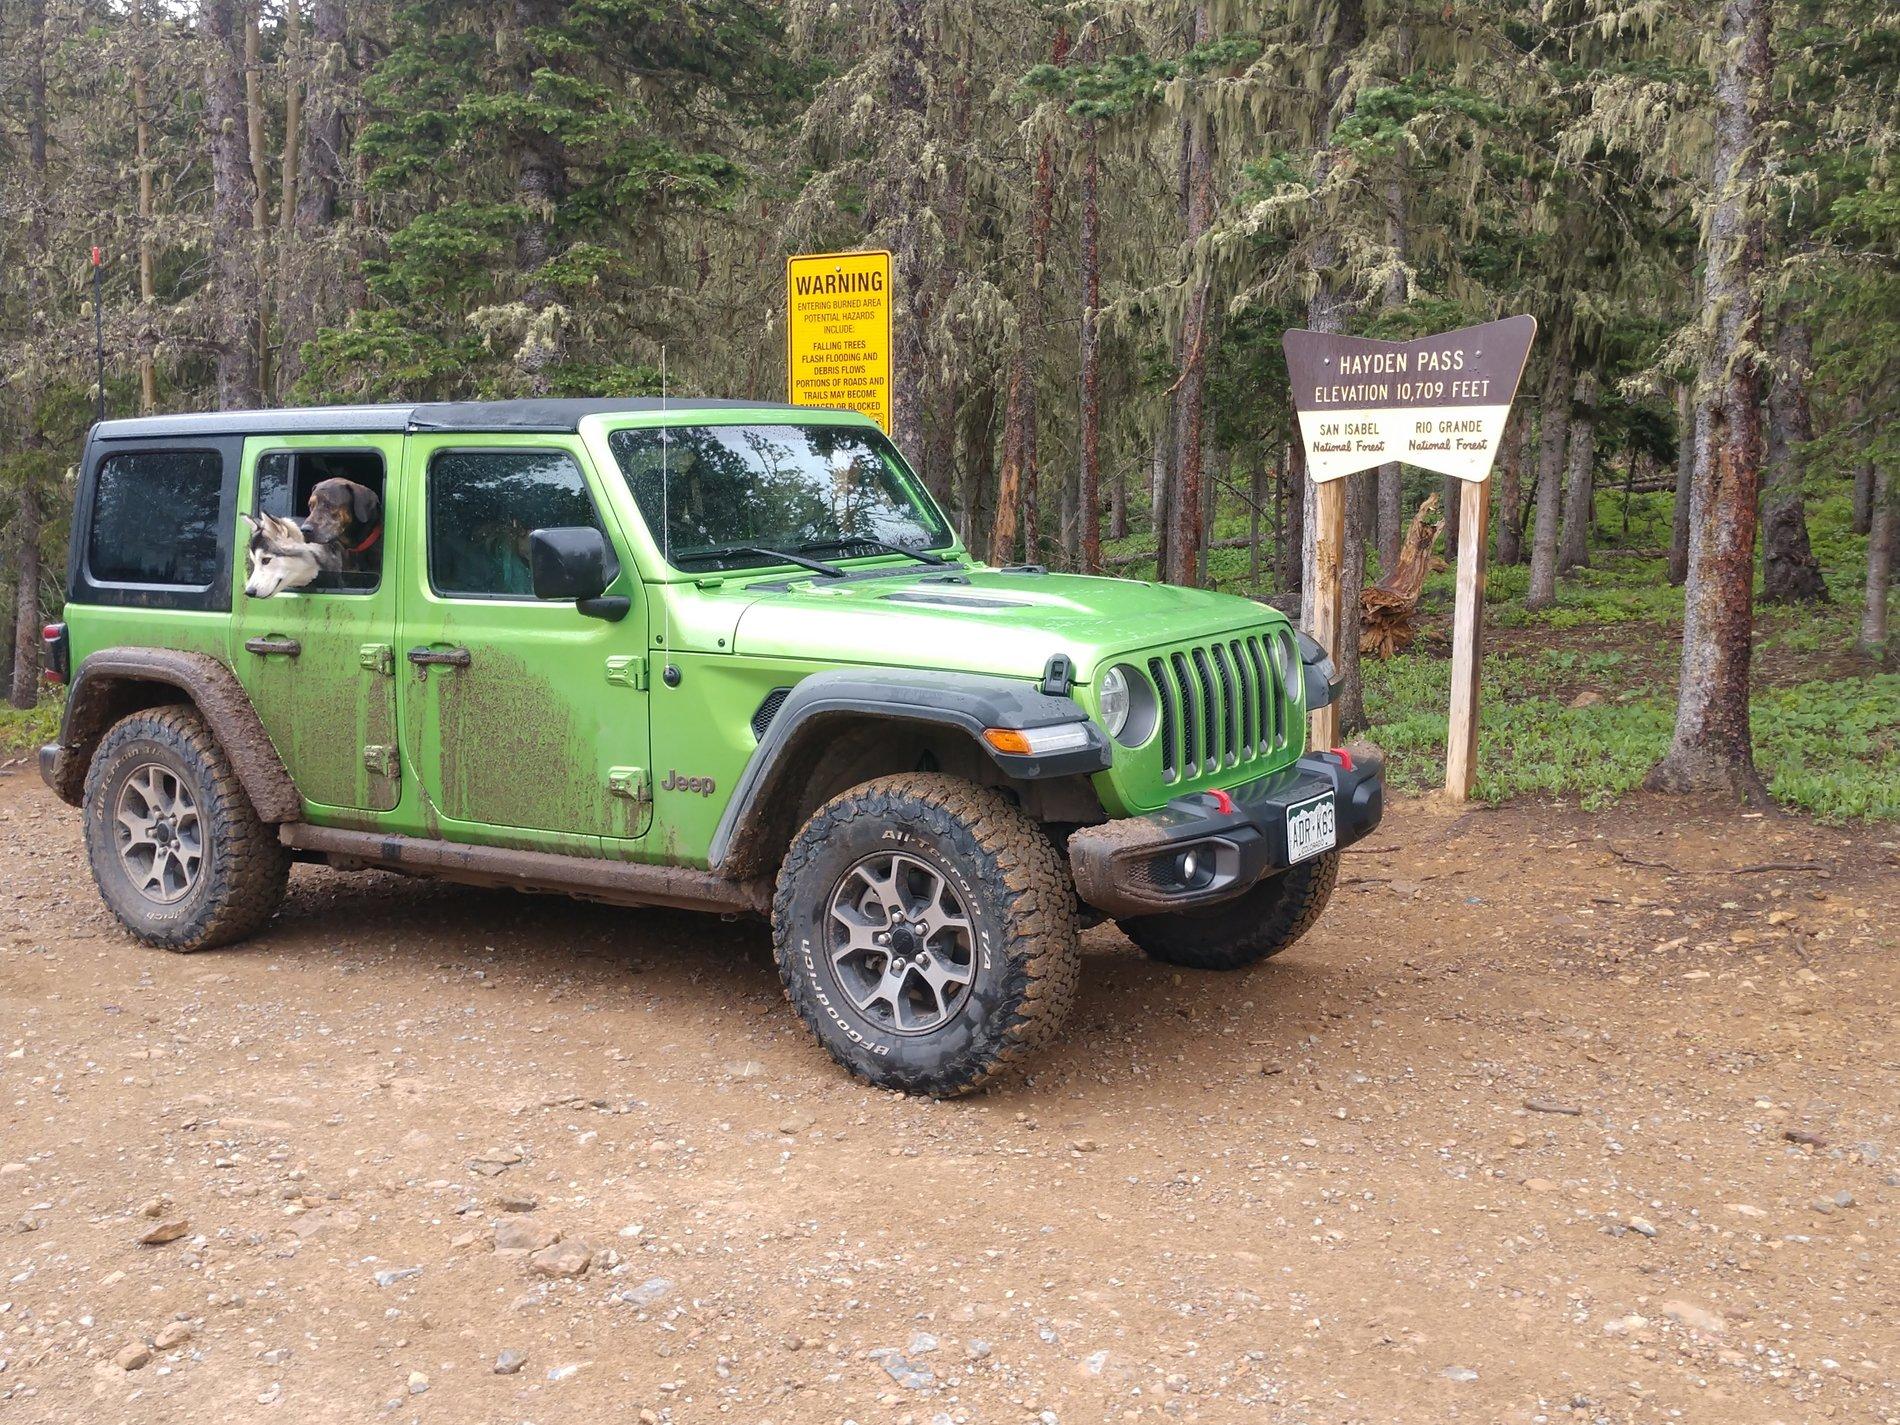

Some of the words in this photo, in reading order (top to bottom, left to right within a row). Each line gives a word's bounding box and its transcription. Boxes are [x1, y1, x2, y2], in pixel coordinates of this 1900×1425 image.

[796, 271, 883, 295] WARNING
[798, 301, 831, 311] ENTERING
[833, 299, 861, 310] BURNED
[863, 298, 881, 308] AREA
[804, 313, 839, 323] POTENTIAL
[842, 311, 875, 321] HAZARDS
[824, 325, 855, 334] INCLUDE:
[813, 341, 842, 350] FALLING
[843, 340, 866, 350] TREES
[802, 354, 824, 363] FLASH
[826, 353, 861, 363] FLOODING
[862, 352, 878, 361] AND
[1340, 353, 1407, 375] HAYDEN
[1417, 350, 1464, 371] PASS
[814, 366, 839, 375] DEBRIS
[842, 365, 866, 374] FLOWS
[796, 379, 830, 388] PORTIONS
[832, 378, 842, 387] OF
[843, 377, 867, 387] ROADS
[869, 376, 884, 386] AND
[804, 391, 828, 400] TRAILS
[830, 391, 845, 399] MAY
[847, 389, 877, 399] BECOME
[1315, 384, 1388, 403] ELEVATION
[1397, 382, 1443, 402] 10,709
[1452, 380, 1490, 398] FEET
[848, 402, 881, 411] BLOCKED
[1320, 424, 1339, 436] SAN
[1344, 422, 1380, 436] ISABEL
[1415, 421, 1432, 433] RIO
[1439, 420, 1483, 433] GRANDE
[1312, 440, 1352, 453] National
[1356, 440, 1385, 452] Forest
[1408, 439, 1451, 451] National
[1456, 438, 1488, 450] Forest
[661, 768, 716, 797] Jeep
[881, 829, 982, 916] All-Terrain
[981, 931, 992, 970] T/A
[801, 939, 891, 1057] BFGoodrich
